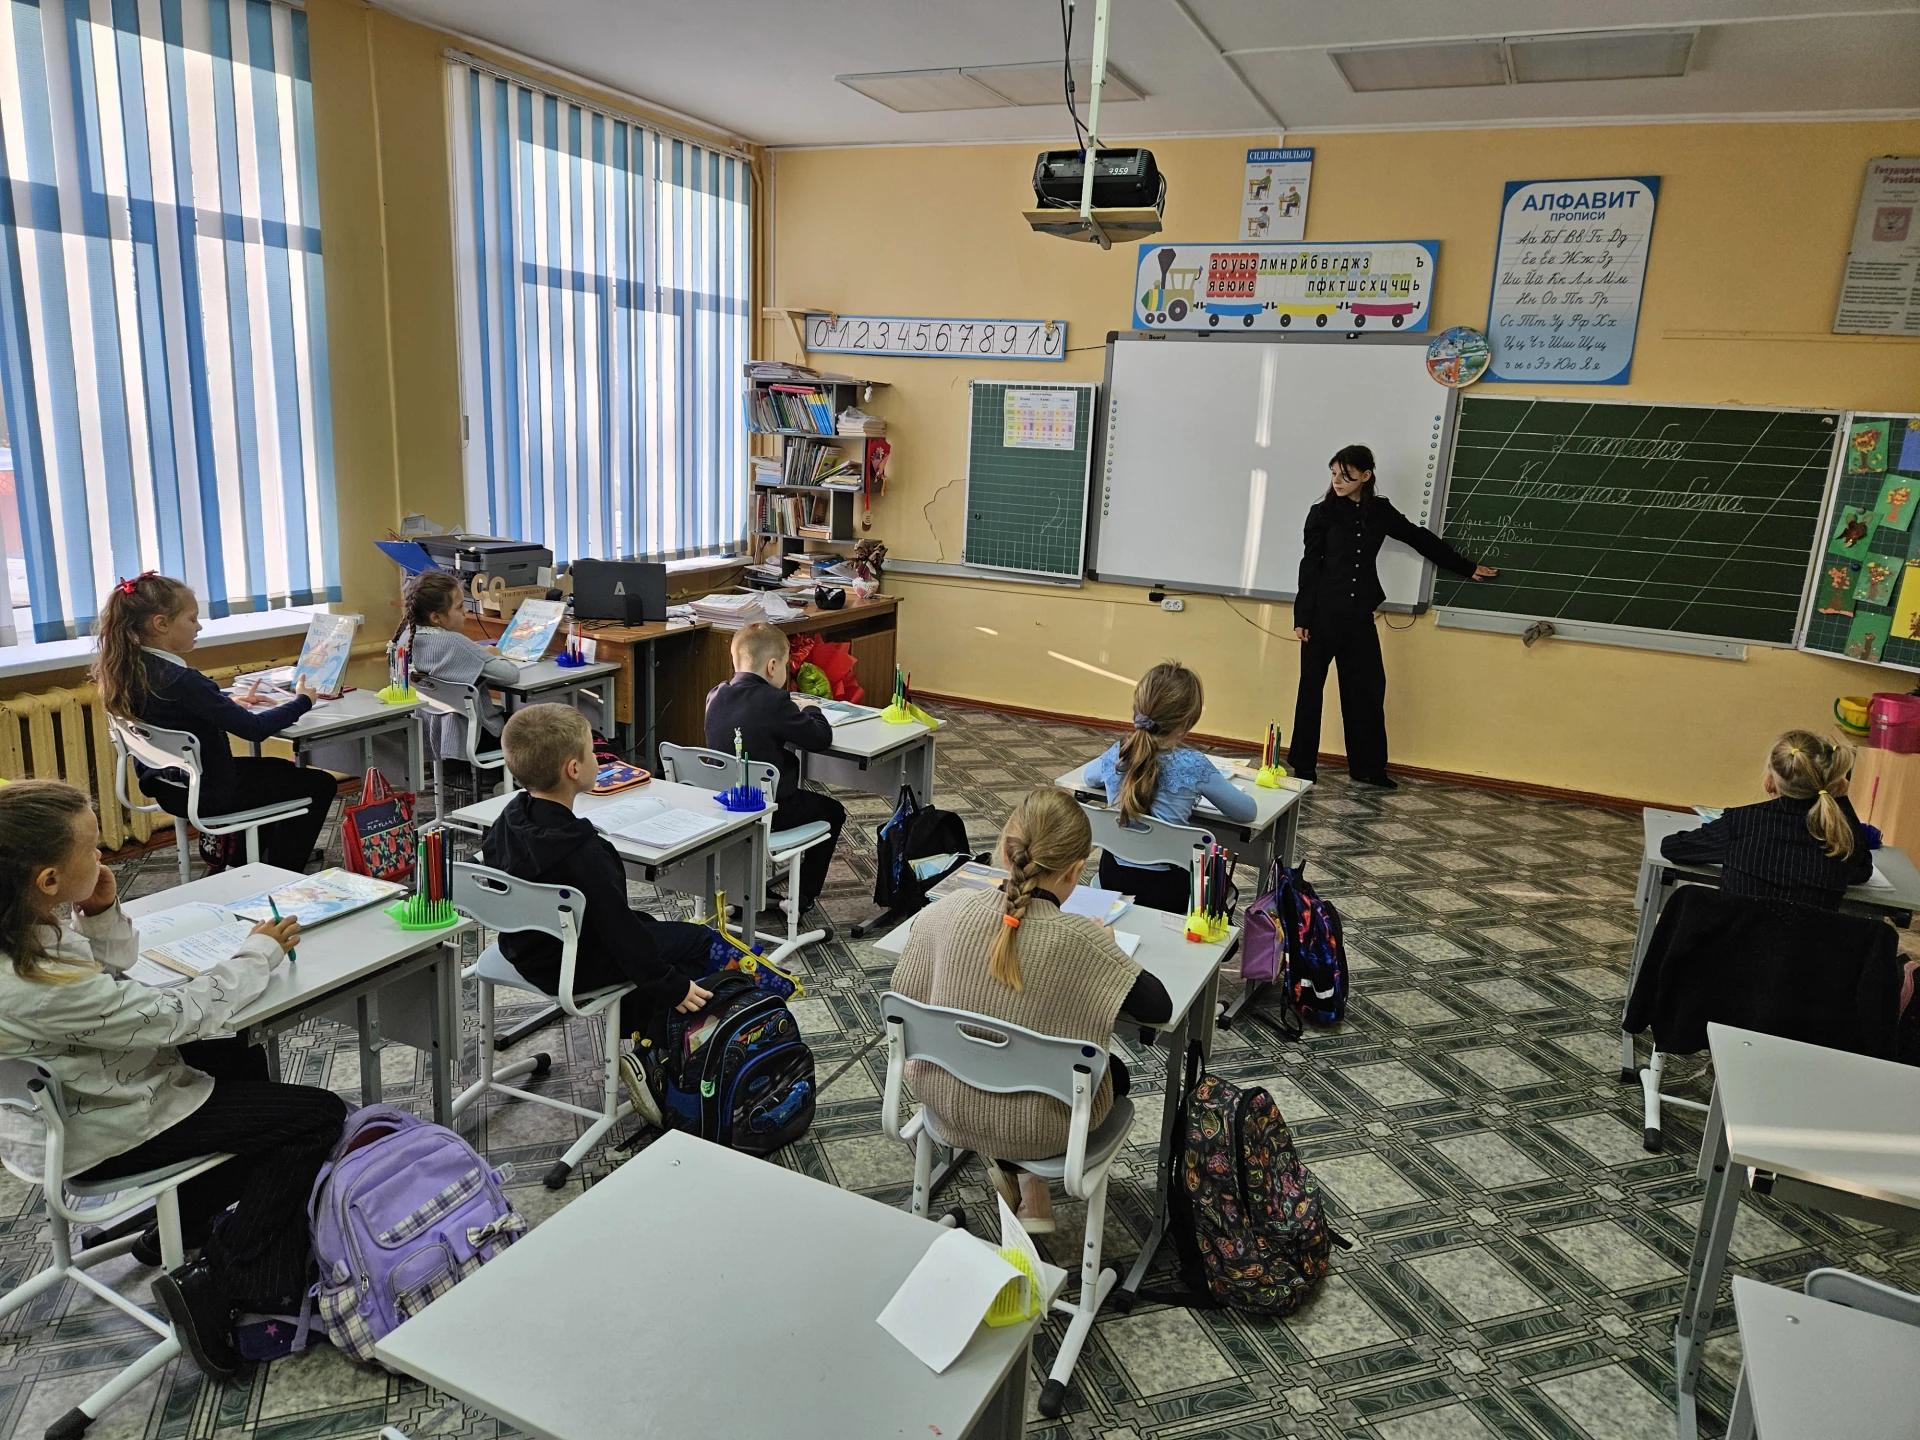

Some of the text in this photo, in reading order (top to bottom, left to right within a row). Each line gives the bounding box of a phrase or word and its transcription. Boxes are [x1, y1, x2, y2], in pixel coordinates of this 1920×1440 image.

[1249, 150, 1311, 161] СИДИ ПРАВИЛЬНО
[1521, 190, 1641, 212] АЛФАВИТ
[1550, 211, 1606, 222] ПРОПИСИ
